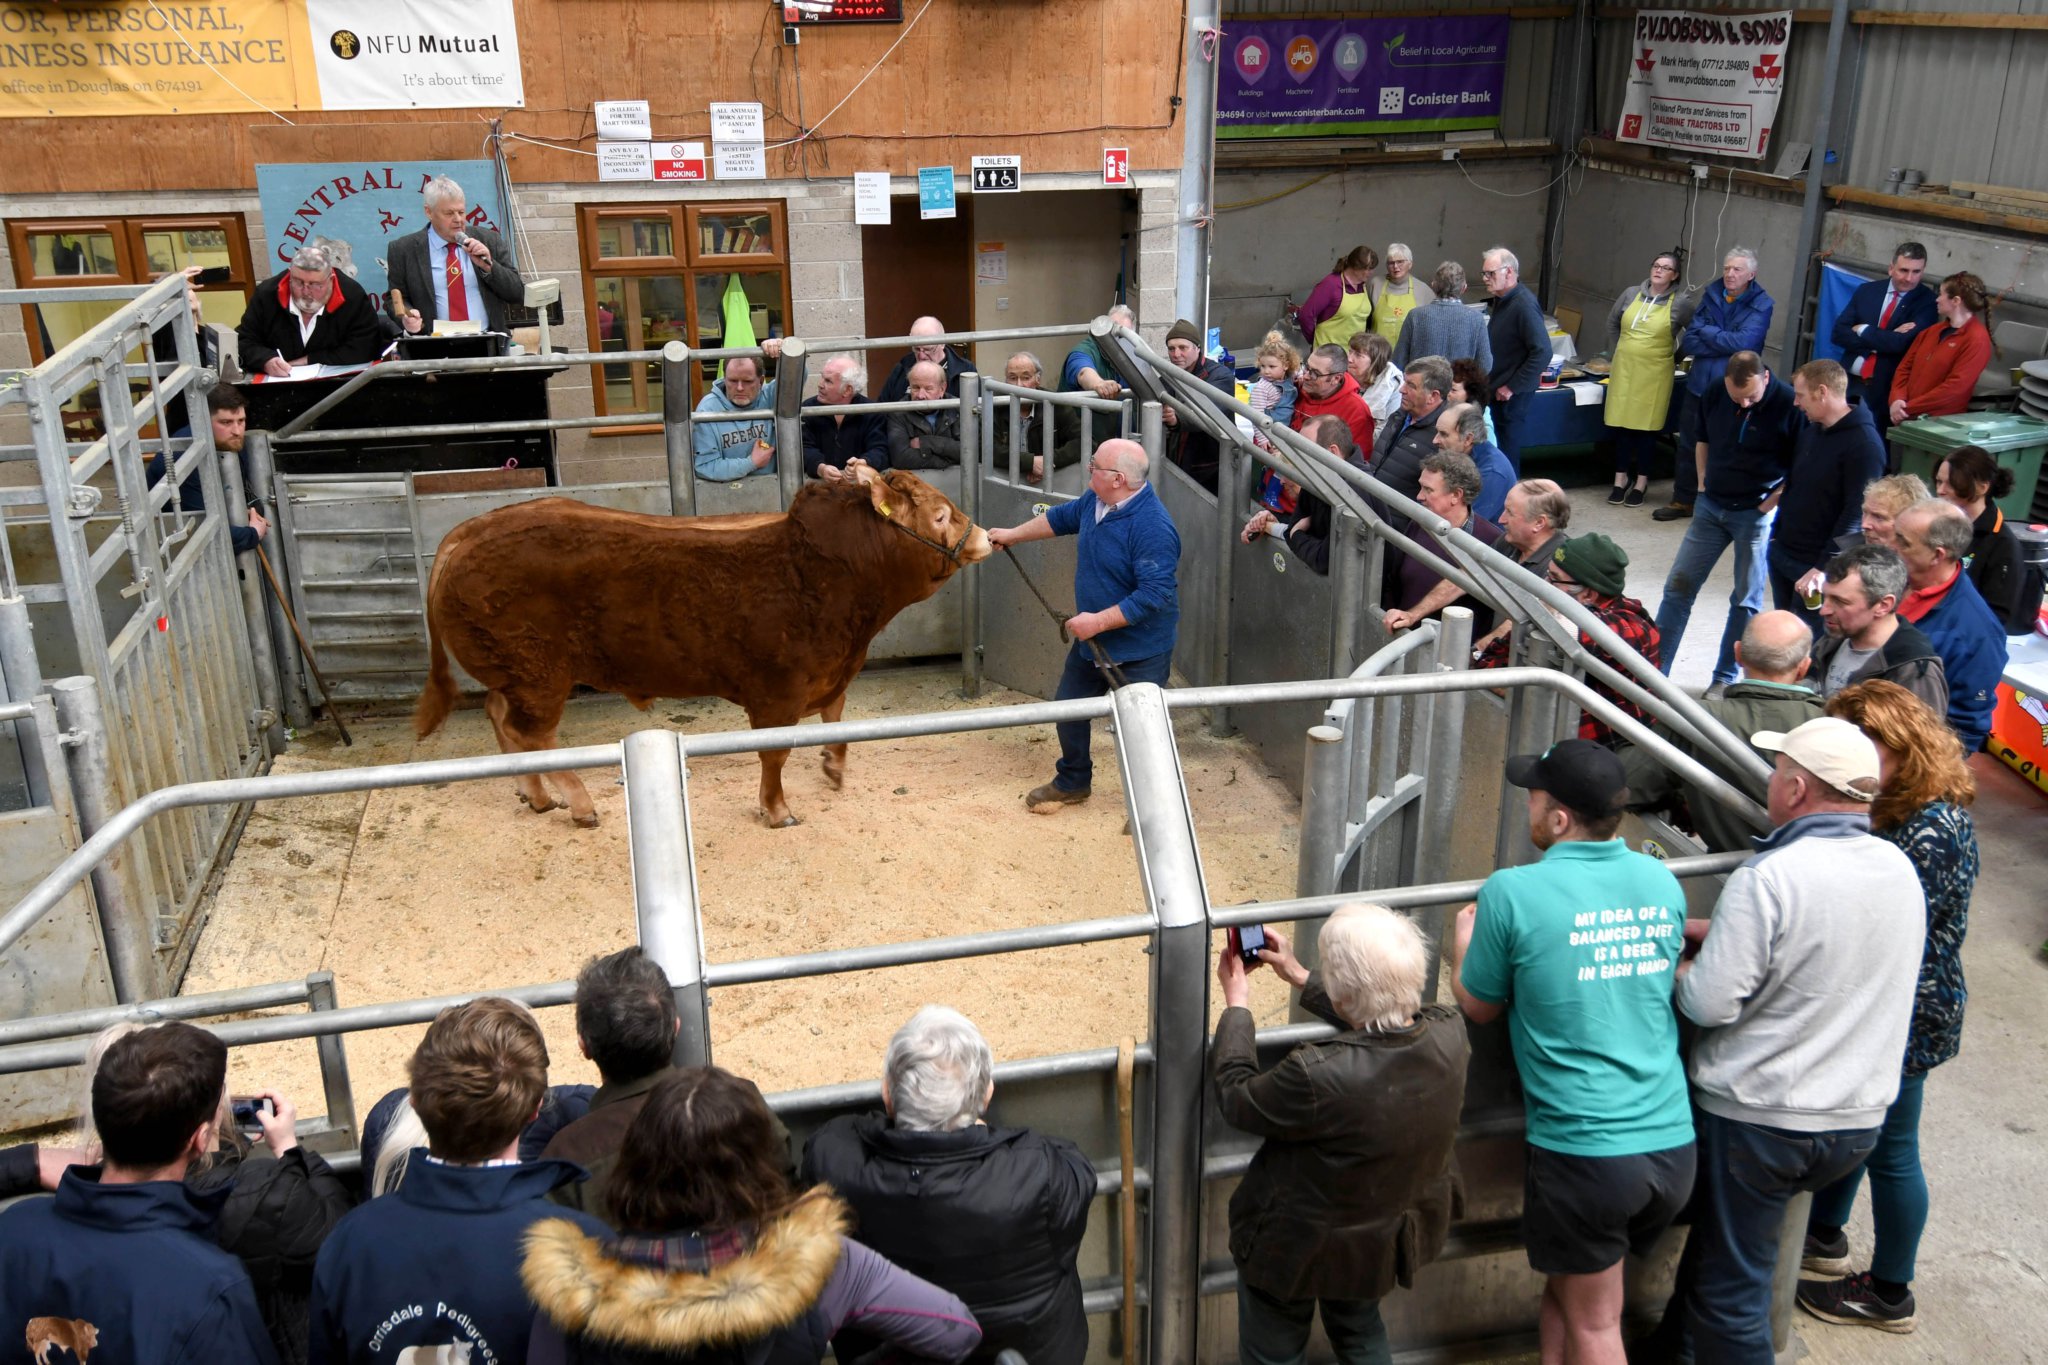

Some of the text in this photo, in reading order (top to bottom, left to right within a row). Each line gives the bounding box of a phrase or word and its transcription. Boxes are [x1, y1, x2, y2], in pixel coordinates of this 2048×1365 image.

[66, 7, 244, 34] PERSONAL,
[805, 12, 818, 20] Avg
[1725, 20, 1741, 45] &
[1739, 17, 1788, 46] SONS
[367, 34, 500, 54] NFU Mutual
[1400, 43, 1497, 57] Belief in Local Agriculture
[98, 40, 286, 67] INSURANCE
[1660, 56, 1750, 71] Mark Hartley 07712 394809
[2, 78, 203, 96] office in Douglas on 674191
[403, 73, 425, 87] It's
[428, 72, 468, 86] about
[1668, 74, 1736, 88] www.pvdobson.com
[1238, 89, 1264, 98] Buildings
[1285, 88, 1314, 96] Machinery
[1337, 86, 1360, 95] Fertilizer
[1408, 90, 1491, 106] Conister Bank
[1246, 111, 1254, 119] or
[1255, 110, 1270, 119] visit
[1271, 106, 1365, 119] www.conisterbank.co.im
[1652, 103, 1747, 119] On Island Parts and Services from
[1655, 115, 1741, 132] BALDRINE TRACTORS LTD
[1694, 134, 1702, 142] on
[980, 157, 1012, 165] TOILETS
[661, 170, 698, 178] SMOKING
[277, 168, 402, 263] CENTRAL
[1575, 906, 1668, 927] MY IDEA OF A
[1569, 924, 1675, 946] BALANCED DIET
[1594, 942, 1657, 961] IS A BEER
[1578, 958, 1670, 981] IN EACH HAND
[368, 1301, 499, 1365] Orrisdale Pedigrees
